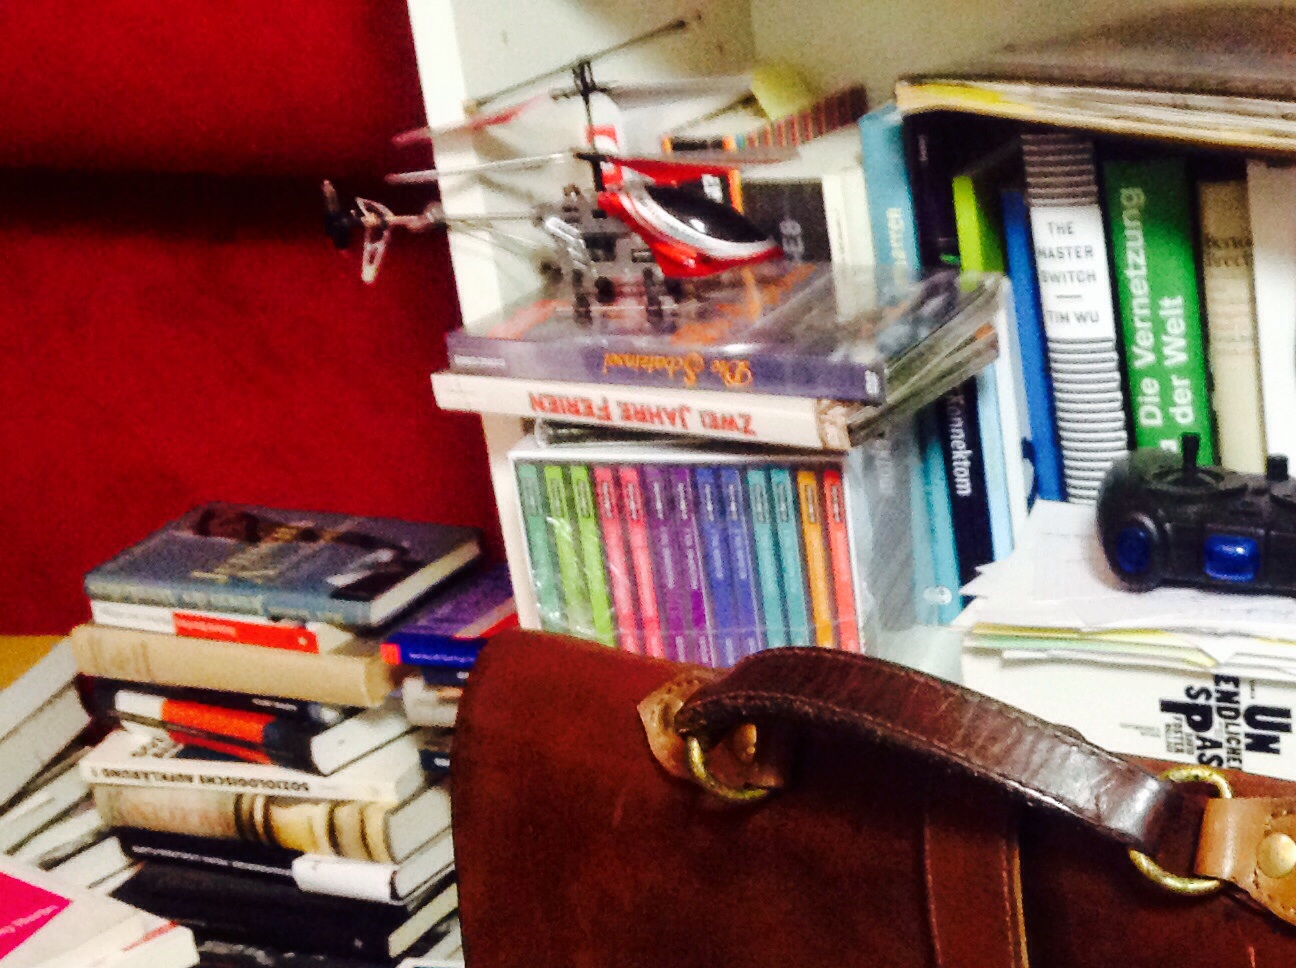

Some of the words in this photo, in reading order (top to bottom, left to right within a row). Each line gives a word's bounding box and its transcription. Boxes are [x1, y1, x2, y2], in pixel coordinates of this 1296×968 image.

[1048, 222, 1074, 237] THE
[1037, 245, 1093, 258] MASTER
[1040, 270, 1096, 283] SWITCH
[1118, 187, 1156, 369] Vernetzung
[1074, 310, 1099, 323] WU
[1159, 295, 1189, 368] Welt
[528, 393, 611, 422] FERIEN
[618, 401, 691, 427] JAHRE
[1139, 377, 1164, 427] Die
[1170, 375, 1194, 424] der
[701, 410, 756, 436] ZWEI
[1159, 685, 1224, 767] SPAS
[1244, 705, 1292, 755] UN
